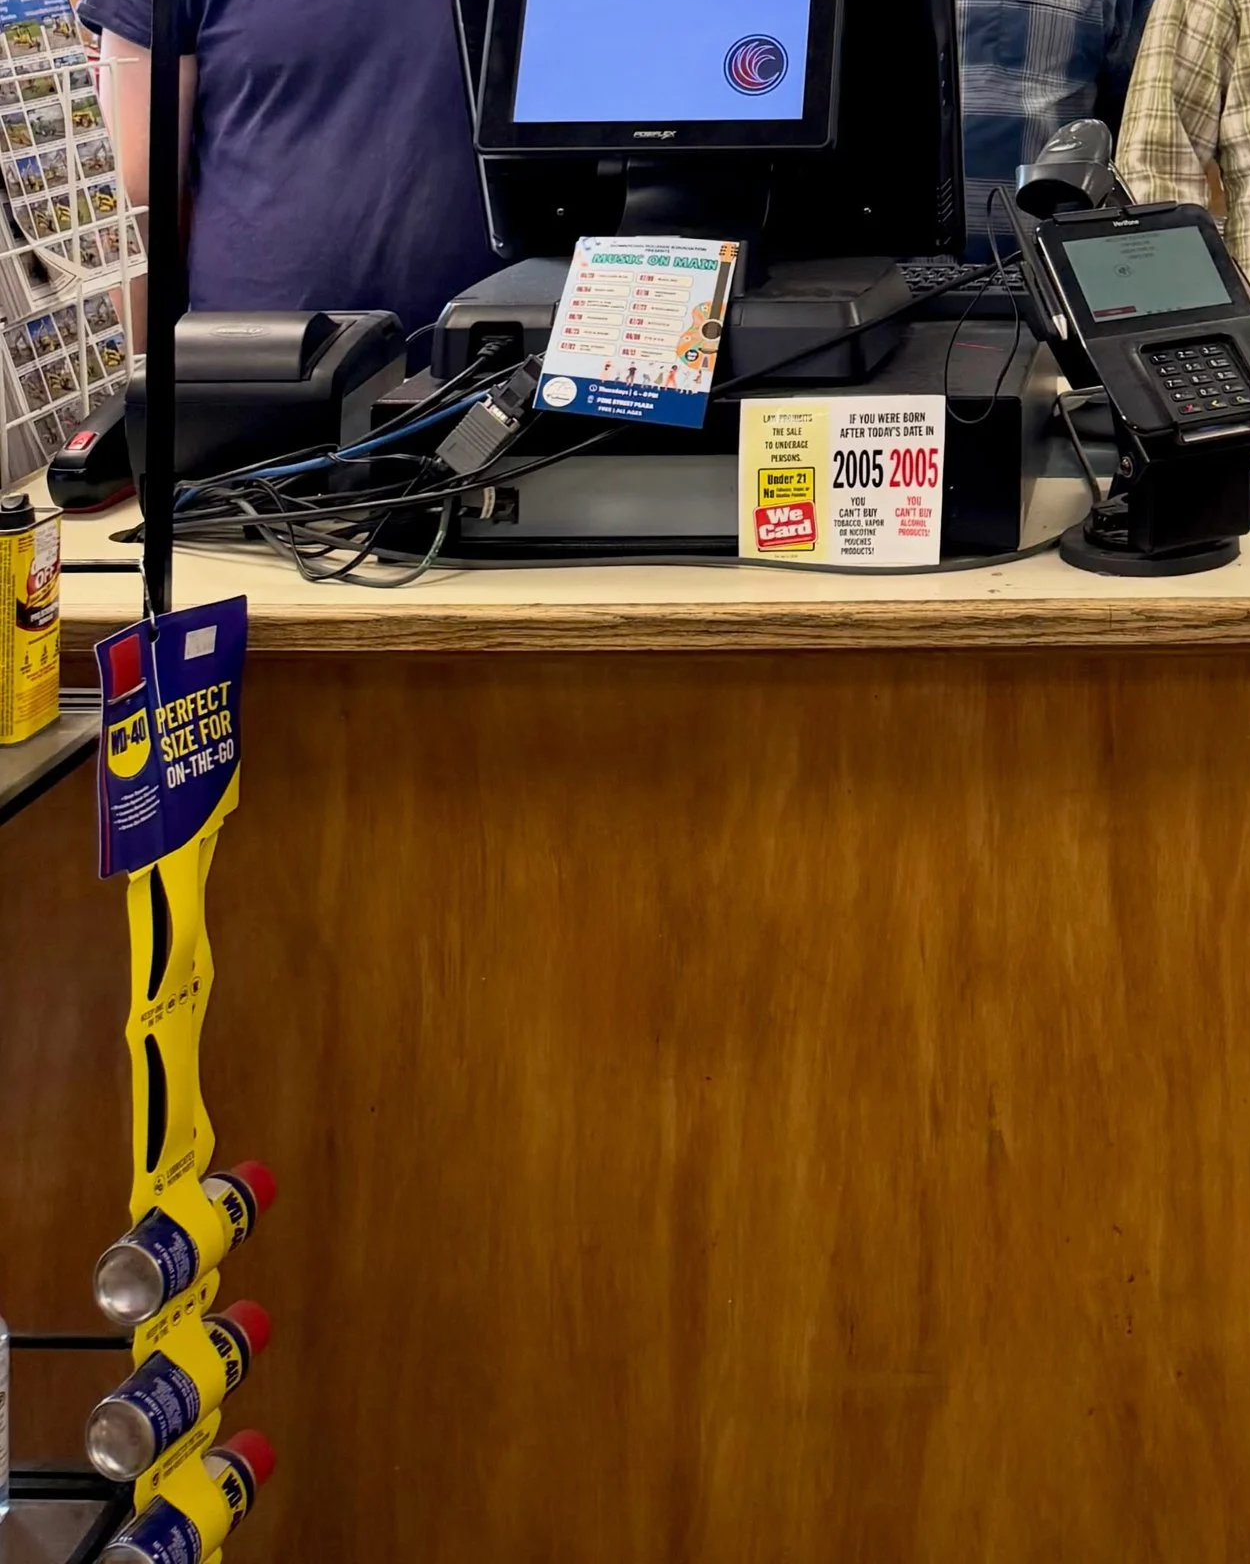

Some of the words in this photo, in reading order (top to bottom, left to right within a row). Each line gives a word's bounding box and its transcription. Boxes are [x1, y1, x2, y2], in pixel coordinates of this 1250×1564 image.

[591, 253, 645, 265] MUSIC
[647, 255, 670, 266] ON
[672, 257, 719, 271] MAIN
[849, 413, 856, 424] IF
[858, 413, 875, 424] YOU
[877, 412, 901, 424] WERE
[902, 412, 926, 423] BORN
[772, 427, 785, 436] THE
[786, 427, 802, 436] SALE
[839, 427, 866, 438] AFTER
[867, 426, 901, 438] TODAY'S
[903, 426, 923, 437] DATE
[925, 426, 935, 436] IN
[832, 449, 884, 489] 2005
[889, 447, 939, 488] 2005
[767, 474, 794, 485] Under
[796, 473, 807, 484] 21
[763, 488, 775, 499] No
[906, 495, 922, 506] YOU
[850, 496, 866, 507] YOU
[766, 506, 804, 525] We
[838, 508, 861, 518] CAN'T
[863, 508, 878, 518] BUY
[894, 507, 917, 518] CAN'T
[919, 508, 933, 518] BUY
[758, 520, 813, 541] Card
[155, 680, 232, 735] PERFECT
[110, 715, 146, 757] WD-40
[160, 724, 199, 763] SIZE
[198, 709, 232, 745] FOR
[166, 738, 235, 789] ON-THE-GO
[208, 1328, 241, 1389] WD-40
